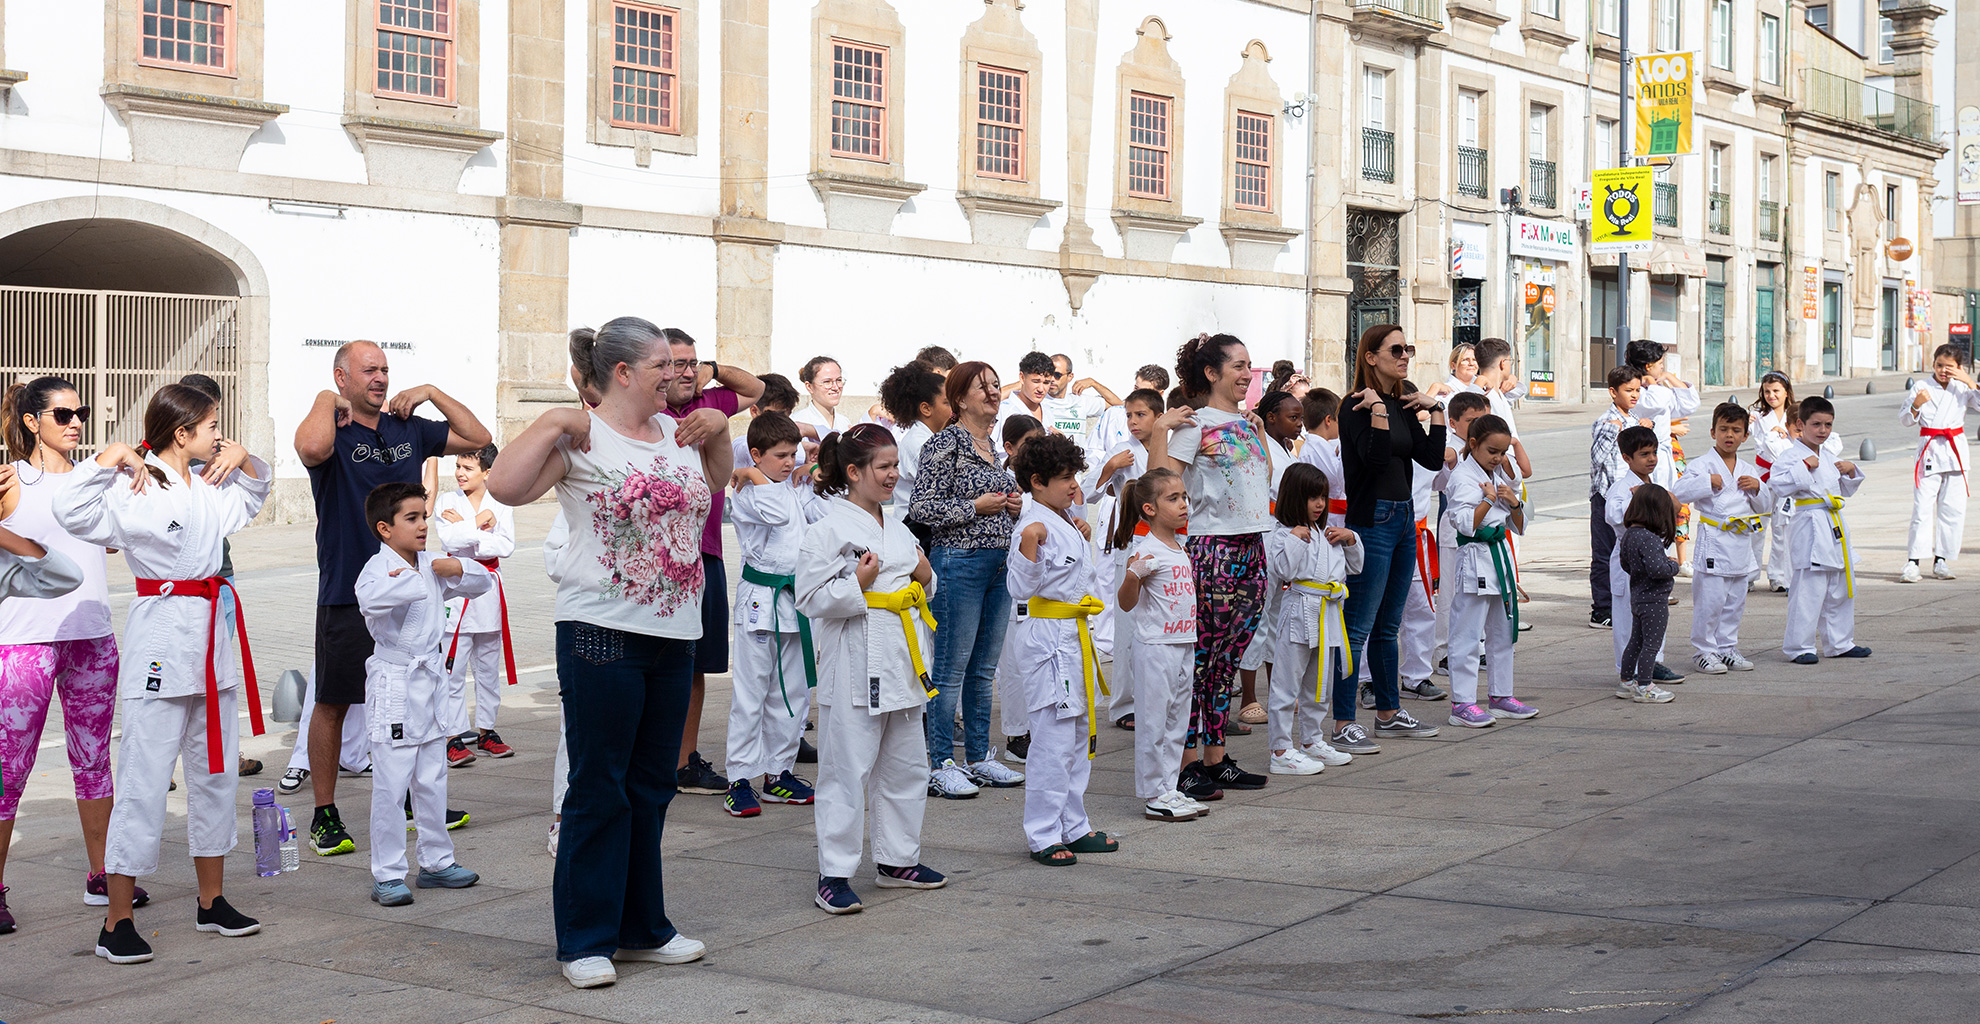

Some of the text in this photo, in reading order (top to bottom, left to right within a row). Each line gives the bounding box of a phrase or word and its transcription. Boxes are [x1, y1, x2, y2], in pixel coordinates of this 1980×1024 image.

[1640, 56, 1687, 83] 100
[1641, 82, 1687, 98] ANOS
[1607, 190, 1638, 203] TODOS
[1608, 213, 1635, 226] Vila Real
[1543, 290, 1554, 304] ria
[1531, 371, 1553, 381] PAGAQUI
